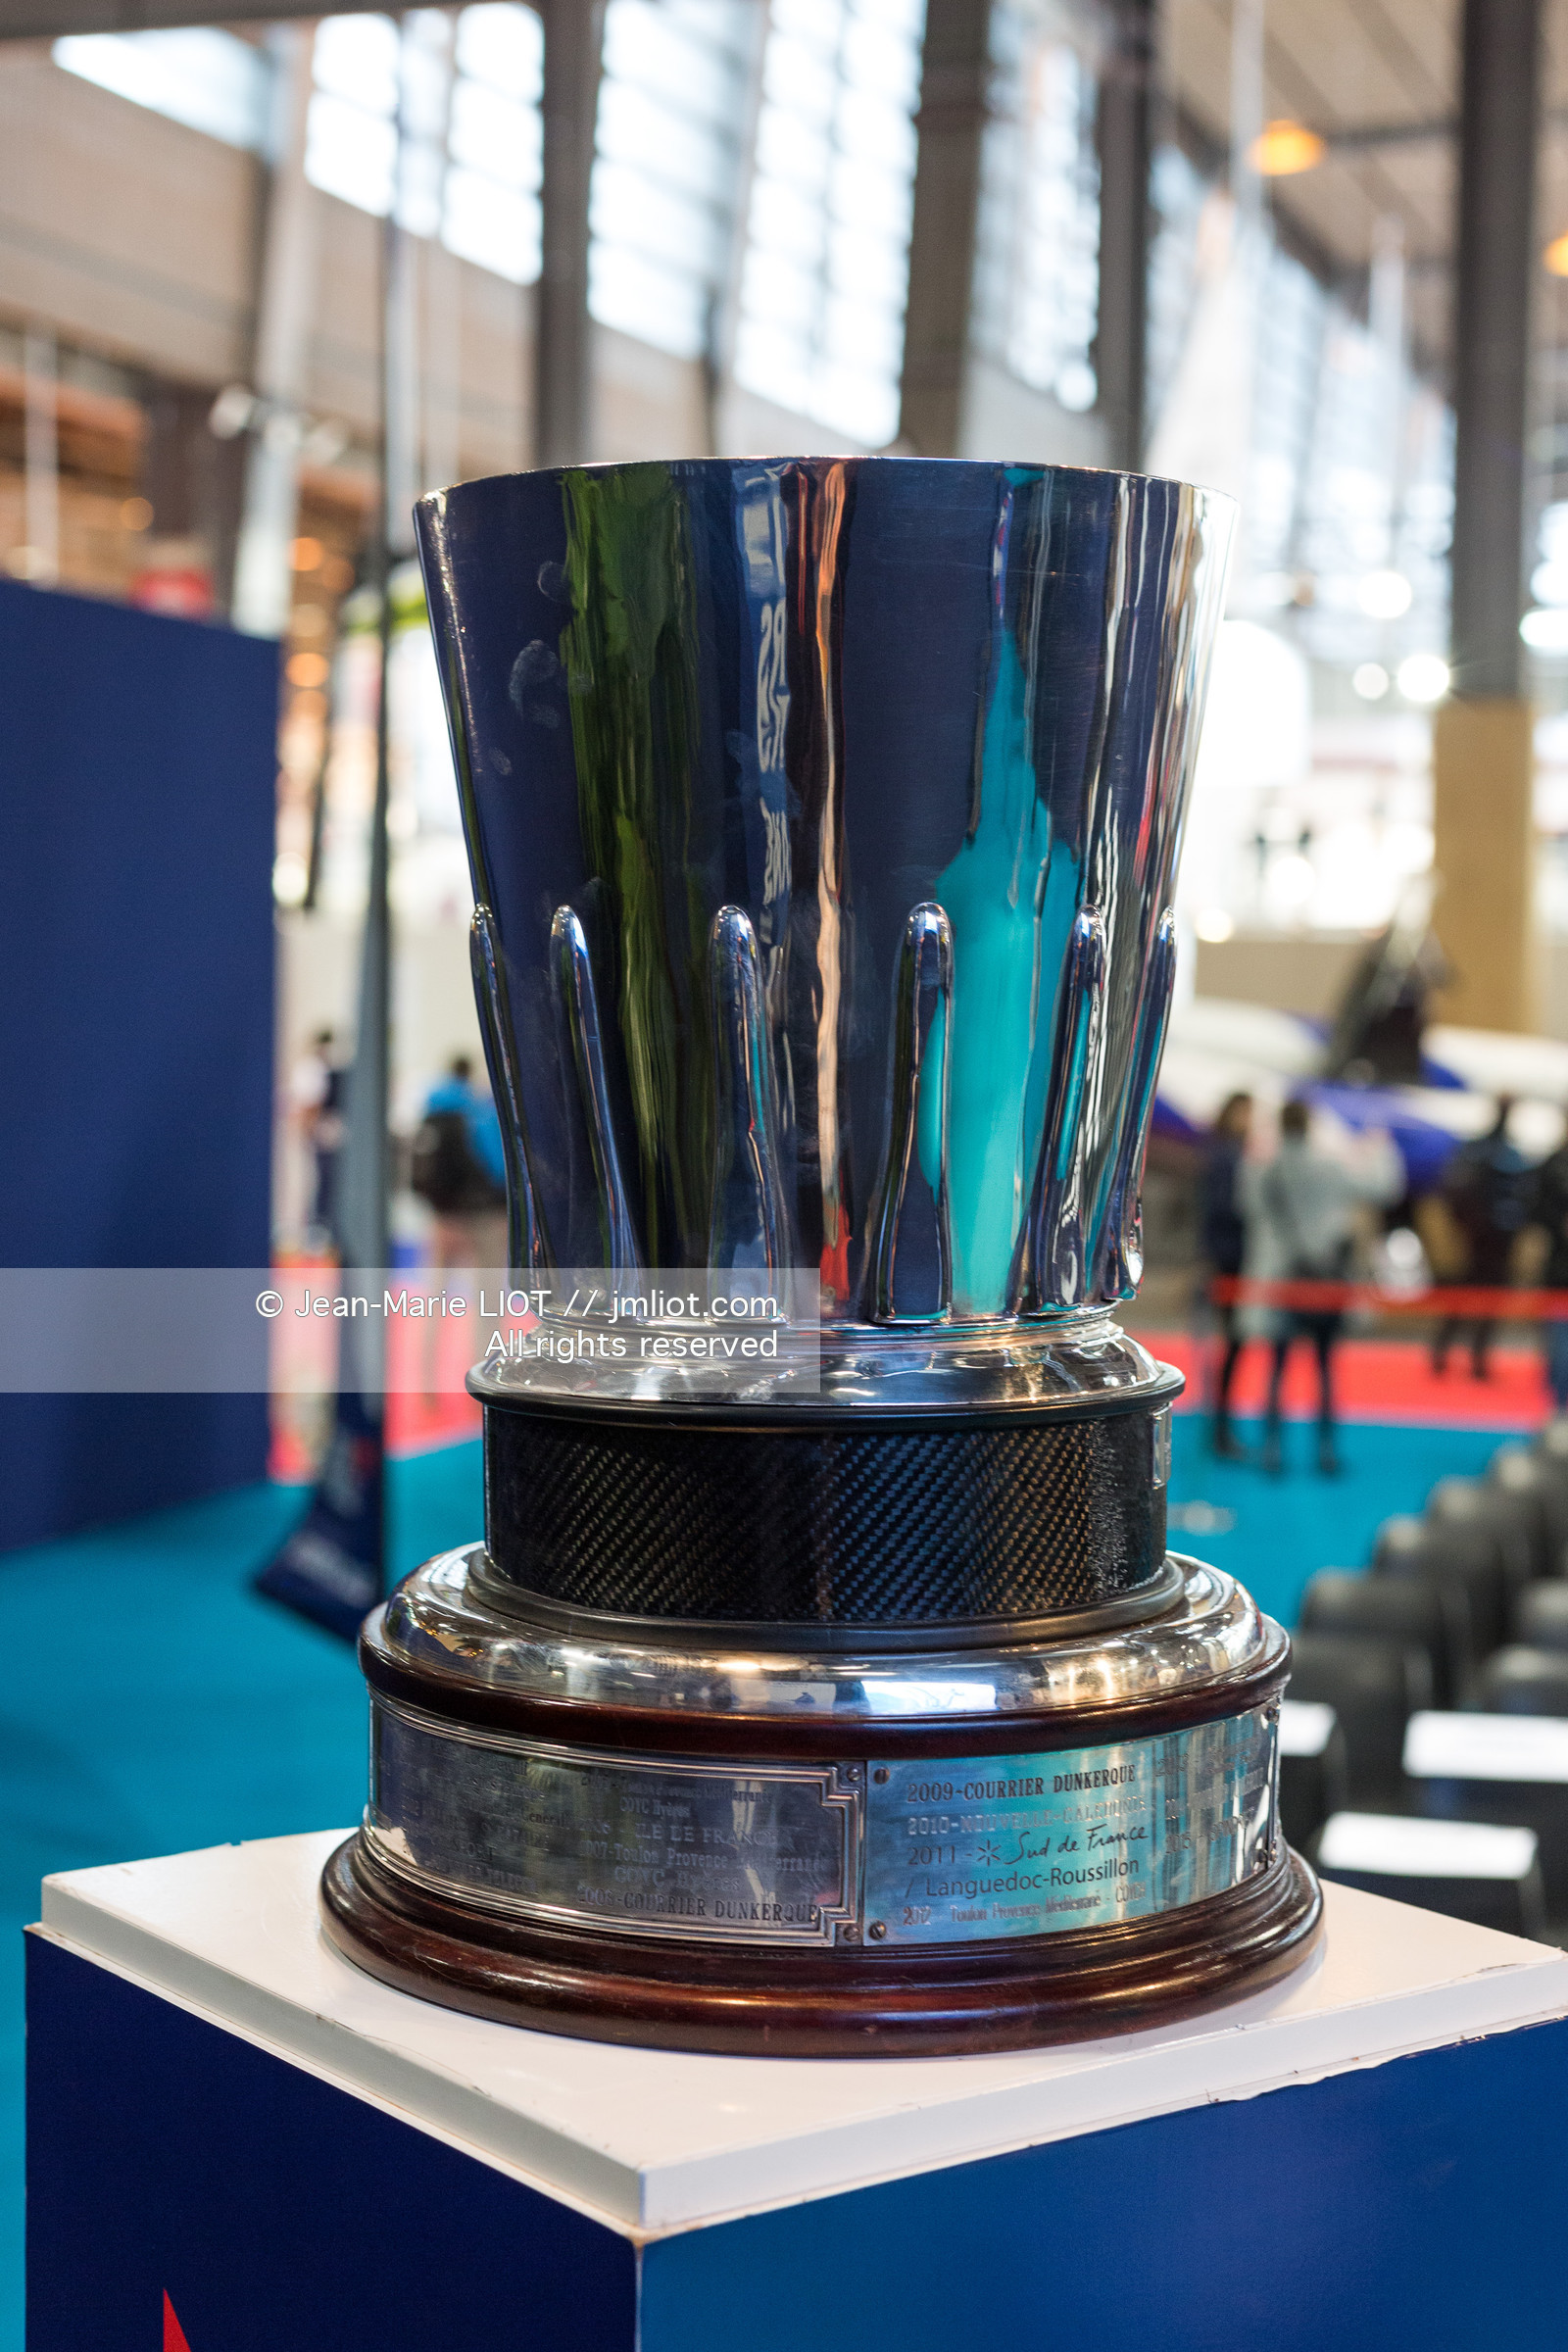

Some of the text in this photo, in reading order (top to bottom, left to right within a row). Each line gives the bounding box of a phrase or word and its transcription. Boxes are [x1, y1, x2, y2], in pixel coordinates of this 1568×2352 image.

[907, 1777, 1045, 1804] 2009-COURRIER
[1053, 1764, 1136, 1793] DUNKERQUE
[907, 1844, 956, 1866] 2011
[1004, 1831, 1052, 1866] Sud
[1056, 1834, 1081, 1853] de
[1086, 1823, 1150, 1851] France
[926, 1857, 1140, 1900] Languedoc-Roussillon
[576, 1884, 820, 1924] 2008-COURRIER DUNKERQUE
